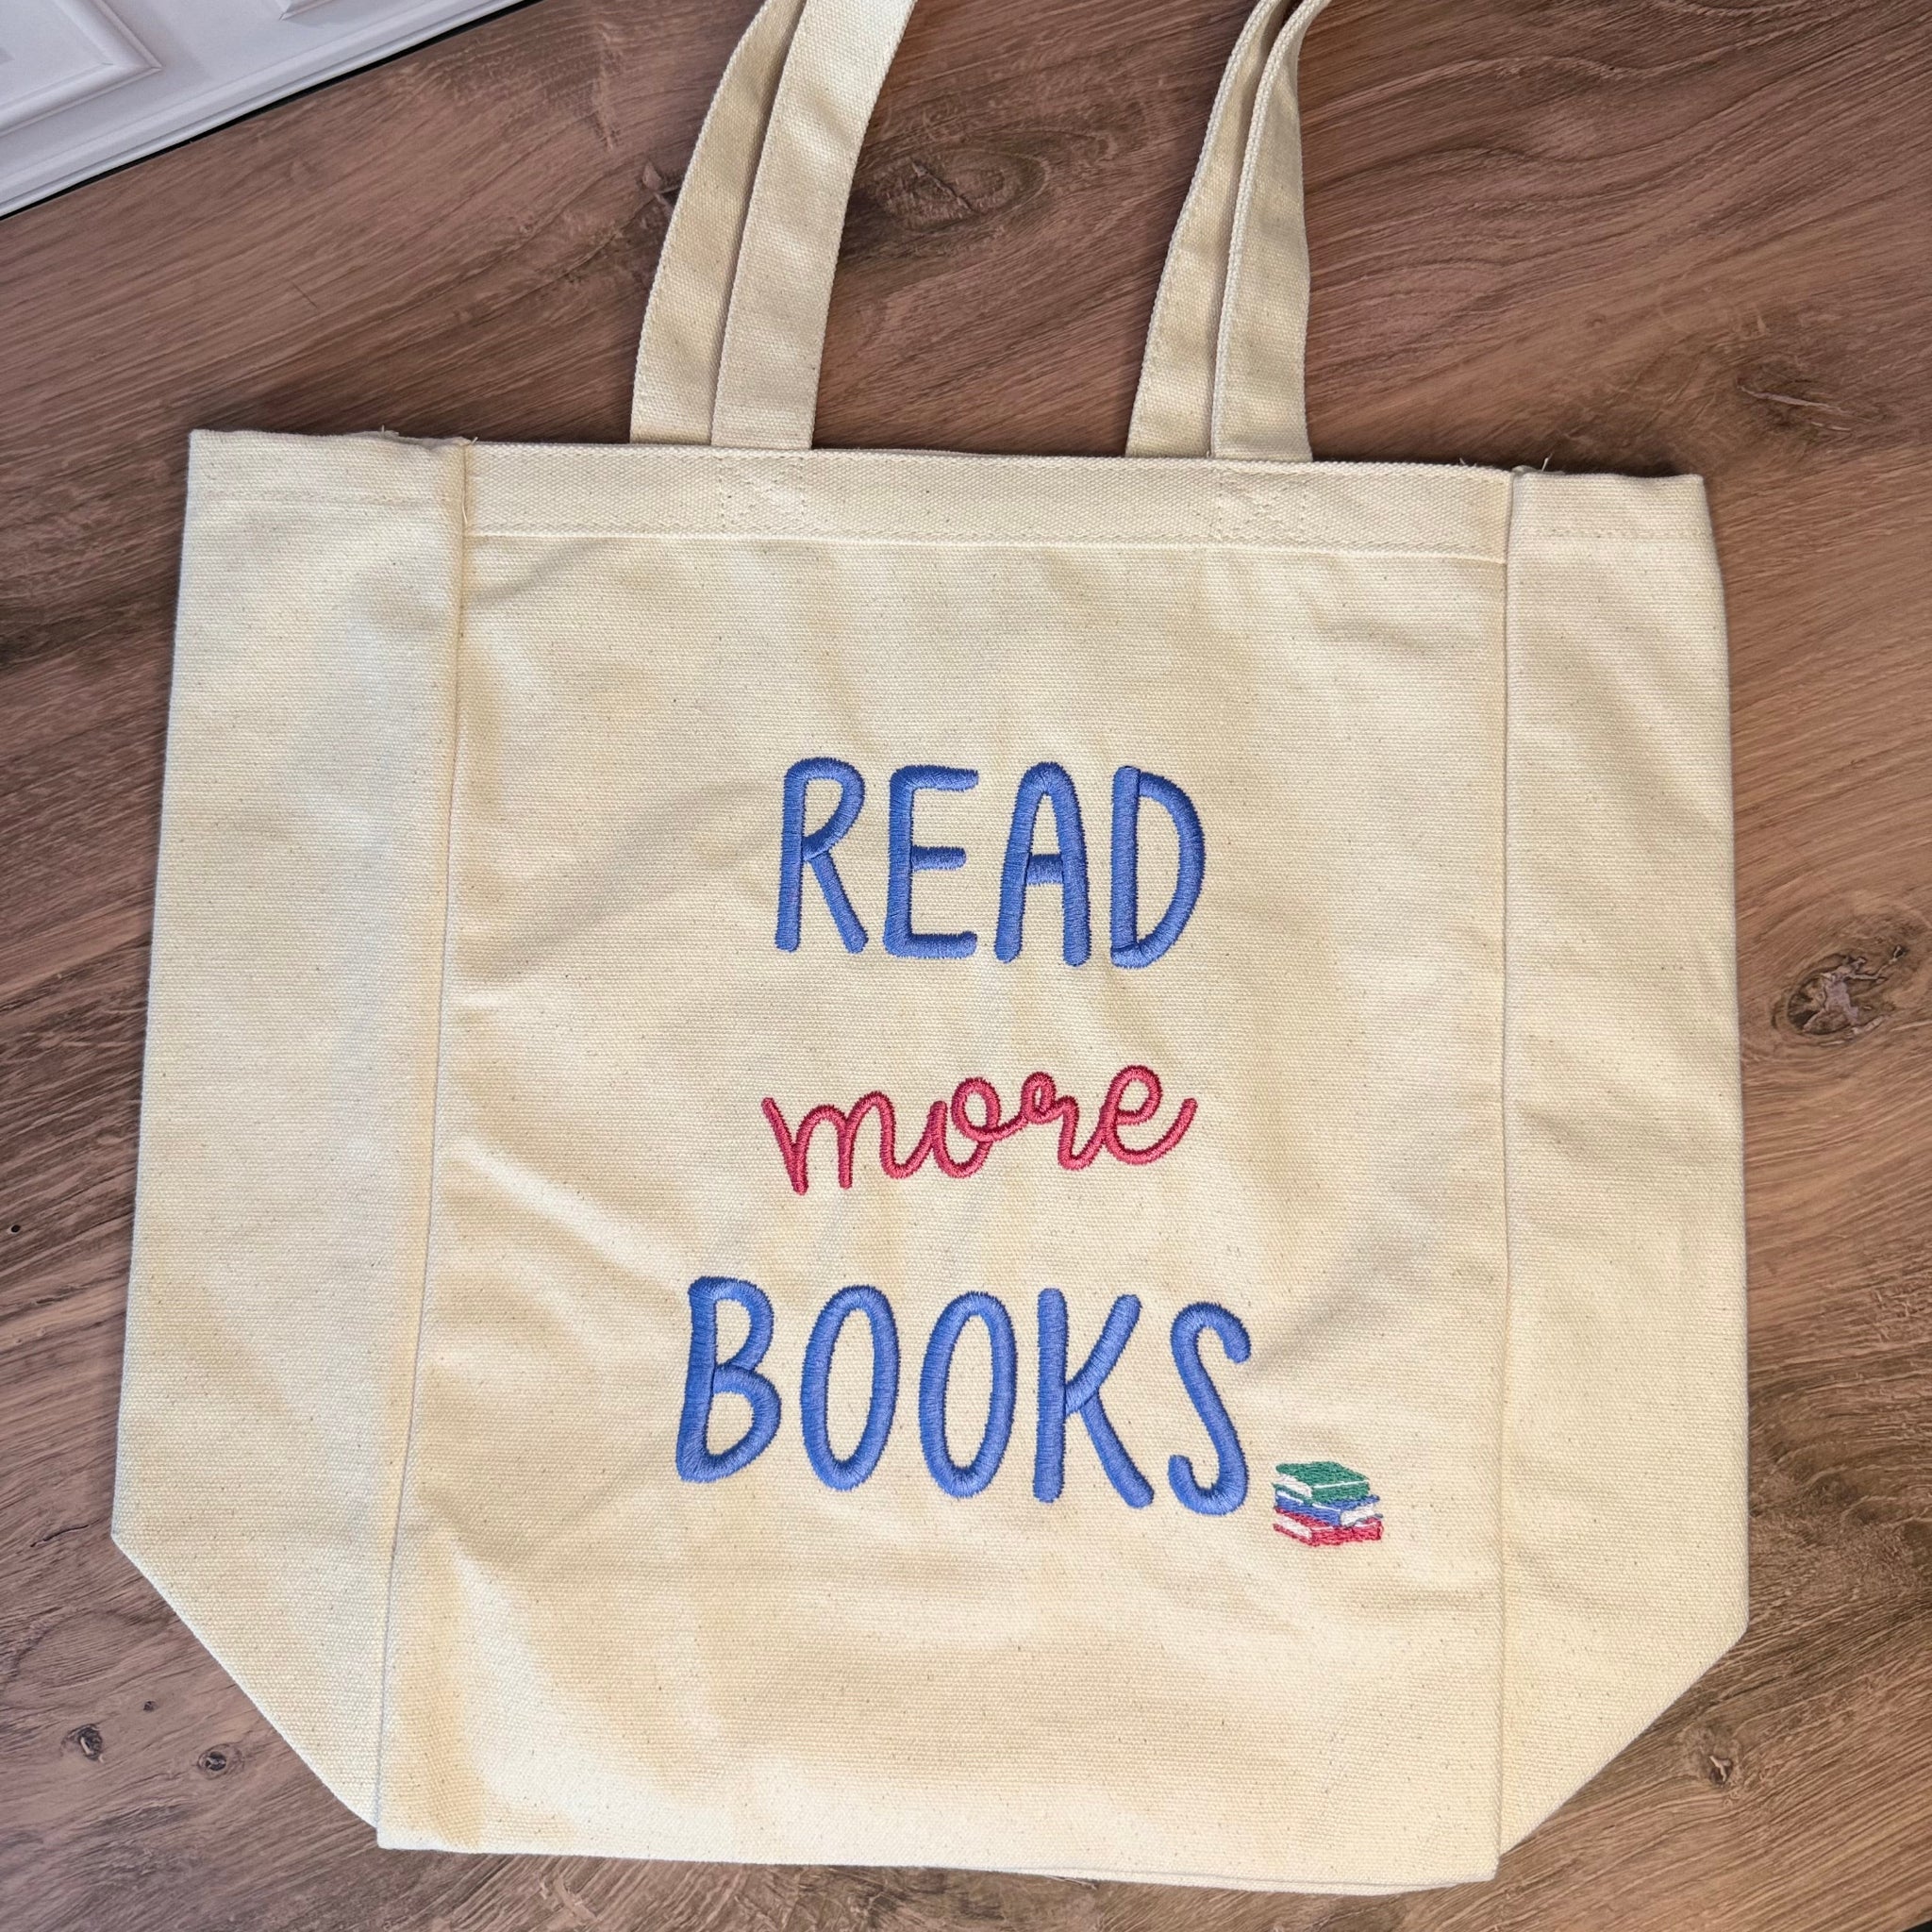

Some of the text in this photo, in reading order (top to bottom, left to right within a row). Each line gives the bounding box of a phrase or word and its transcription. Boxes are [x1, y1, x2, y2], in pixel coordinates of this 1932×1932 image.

[774, 757, 1206, 969] READ
[761, 1064, 1198, 1196] more
[675, 1276, 1251, 1516] BOOKS
